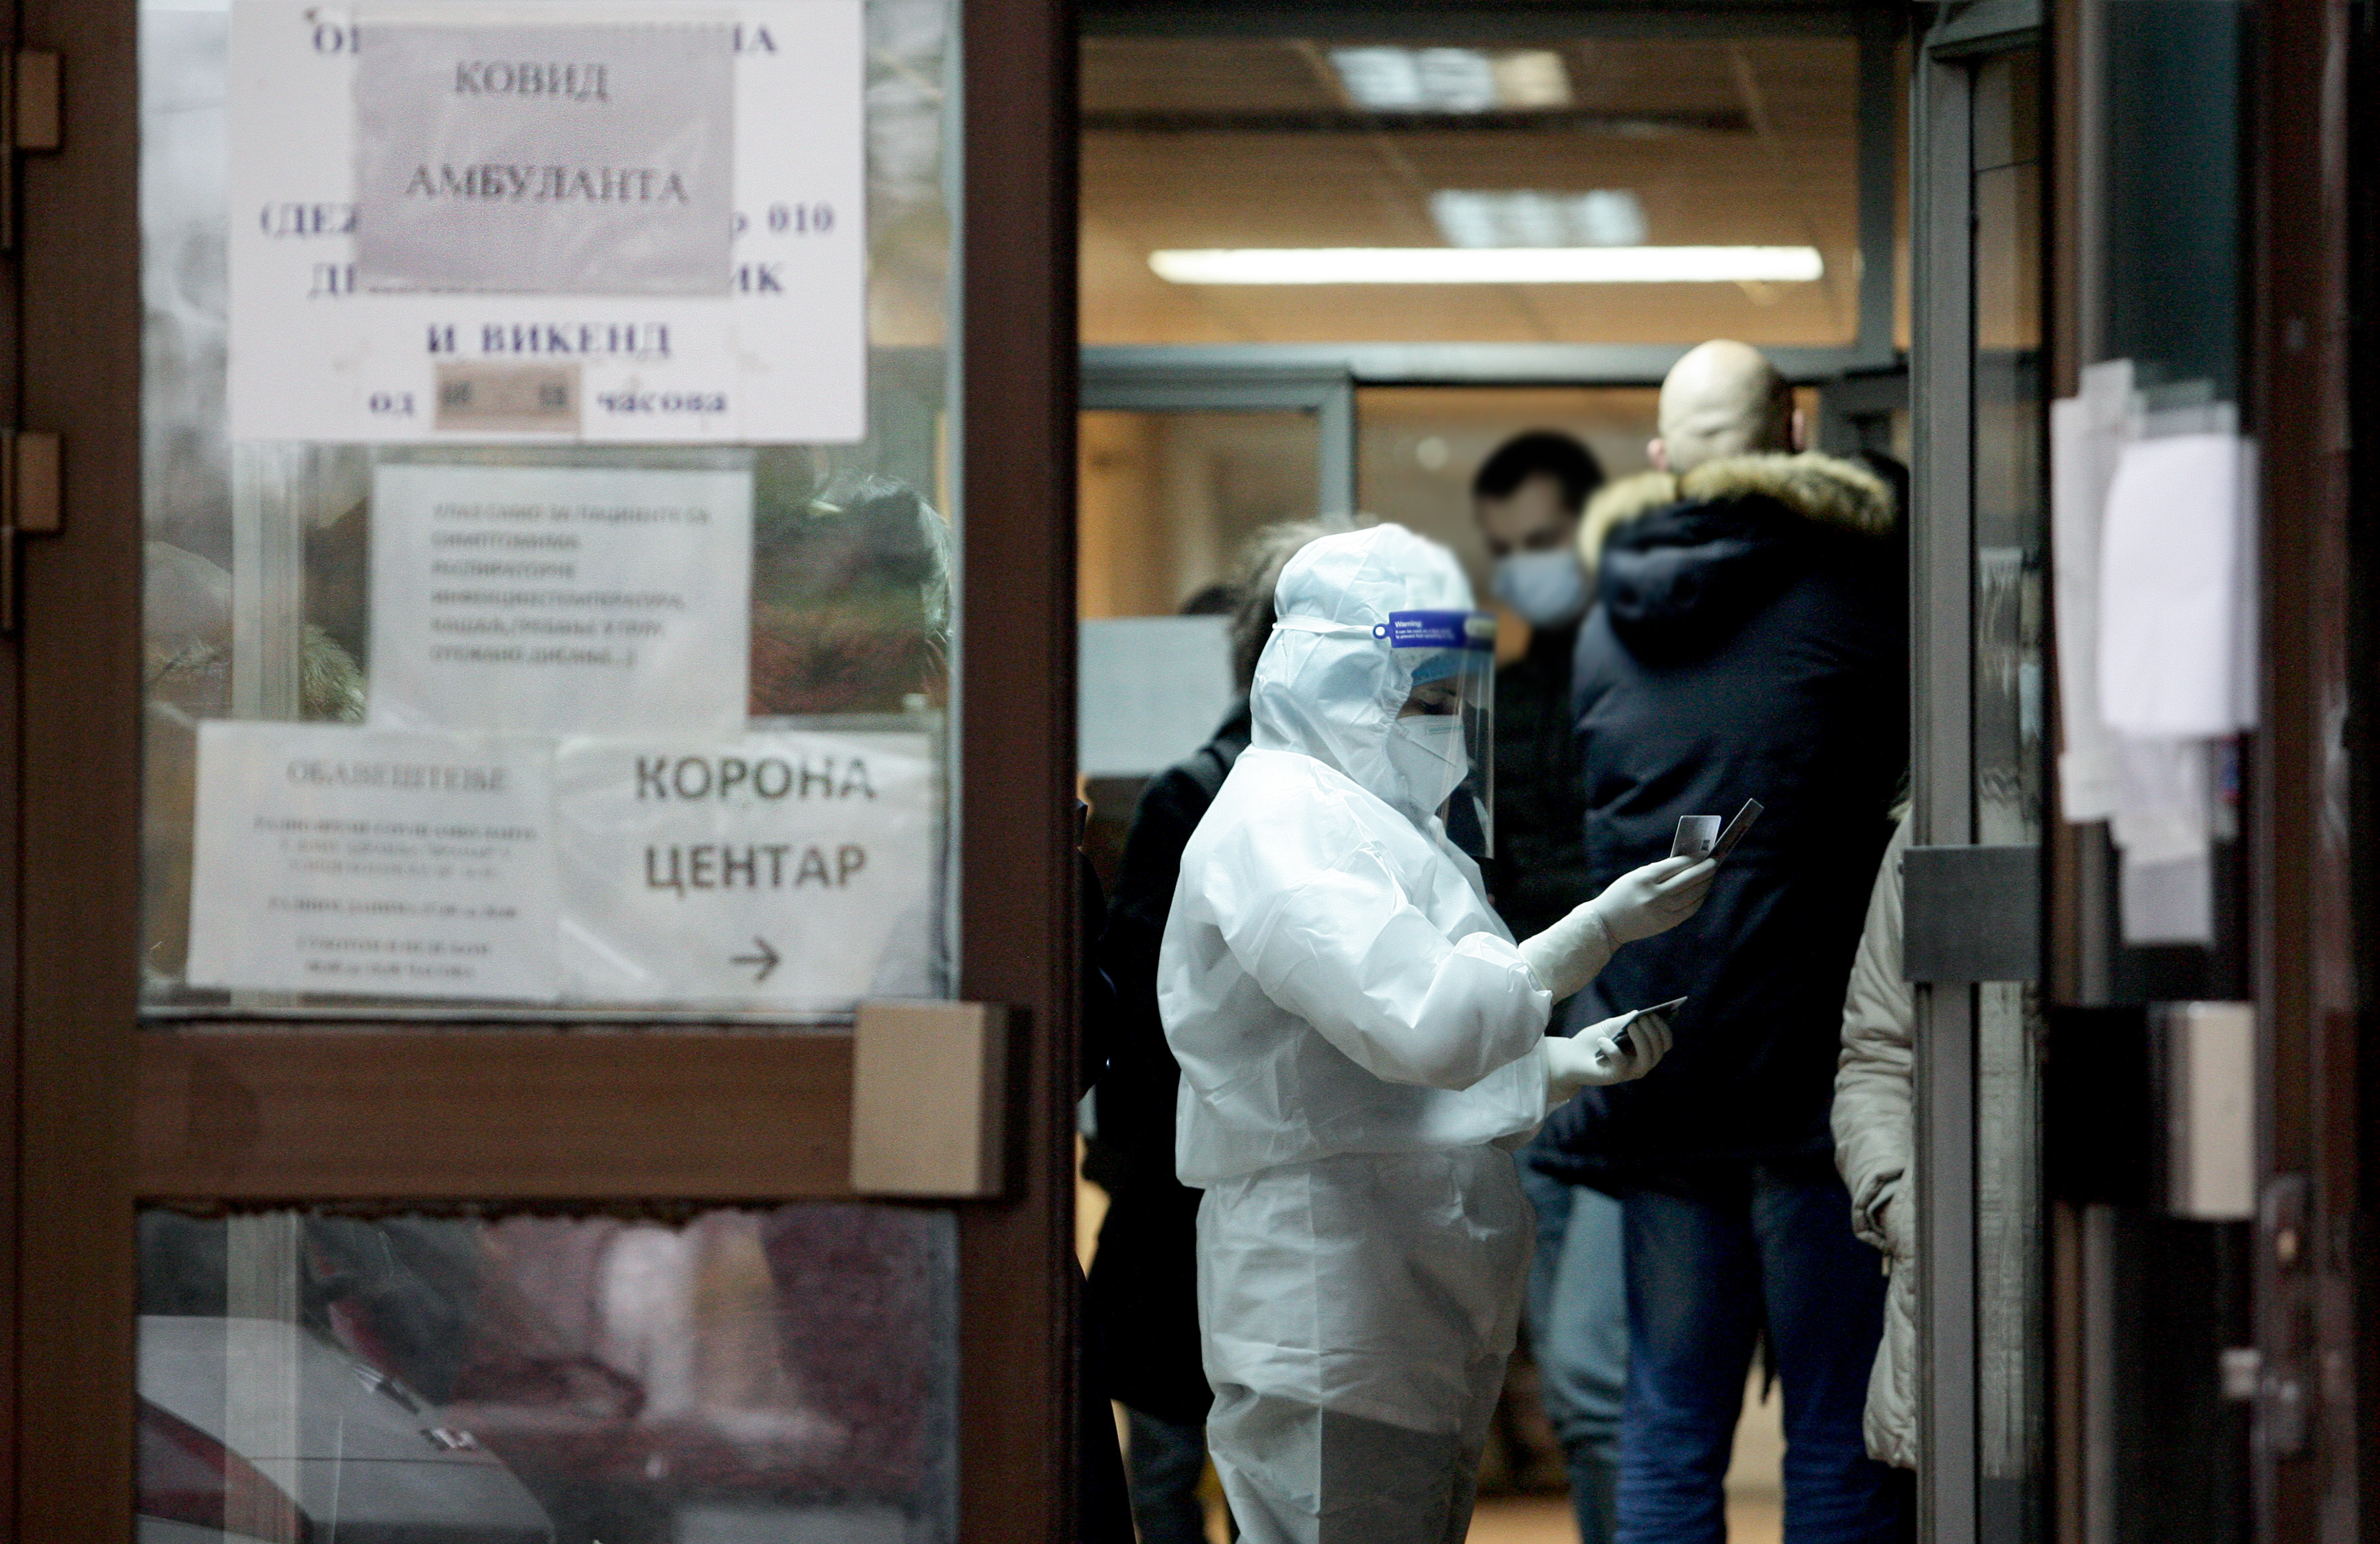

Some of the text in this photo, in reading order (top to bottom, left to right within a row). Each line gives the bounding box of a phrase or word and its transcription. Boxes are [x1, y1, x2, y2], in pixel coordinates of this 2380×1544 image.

[455, 60, 609, 102] КОВИД
[405, 163, 692, 206] АМБУЛАНТА
[767, 202, 835, 234] 010
[426, 323, 672, 360] И ВИКЕНД
[369, 391, 415, 417] од
[596, 391, 728, 415] часова
[635, 756, 877, 800] КОРОНА
[645, 844, 867, 898] ЦЕНТАР
